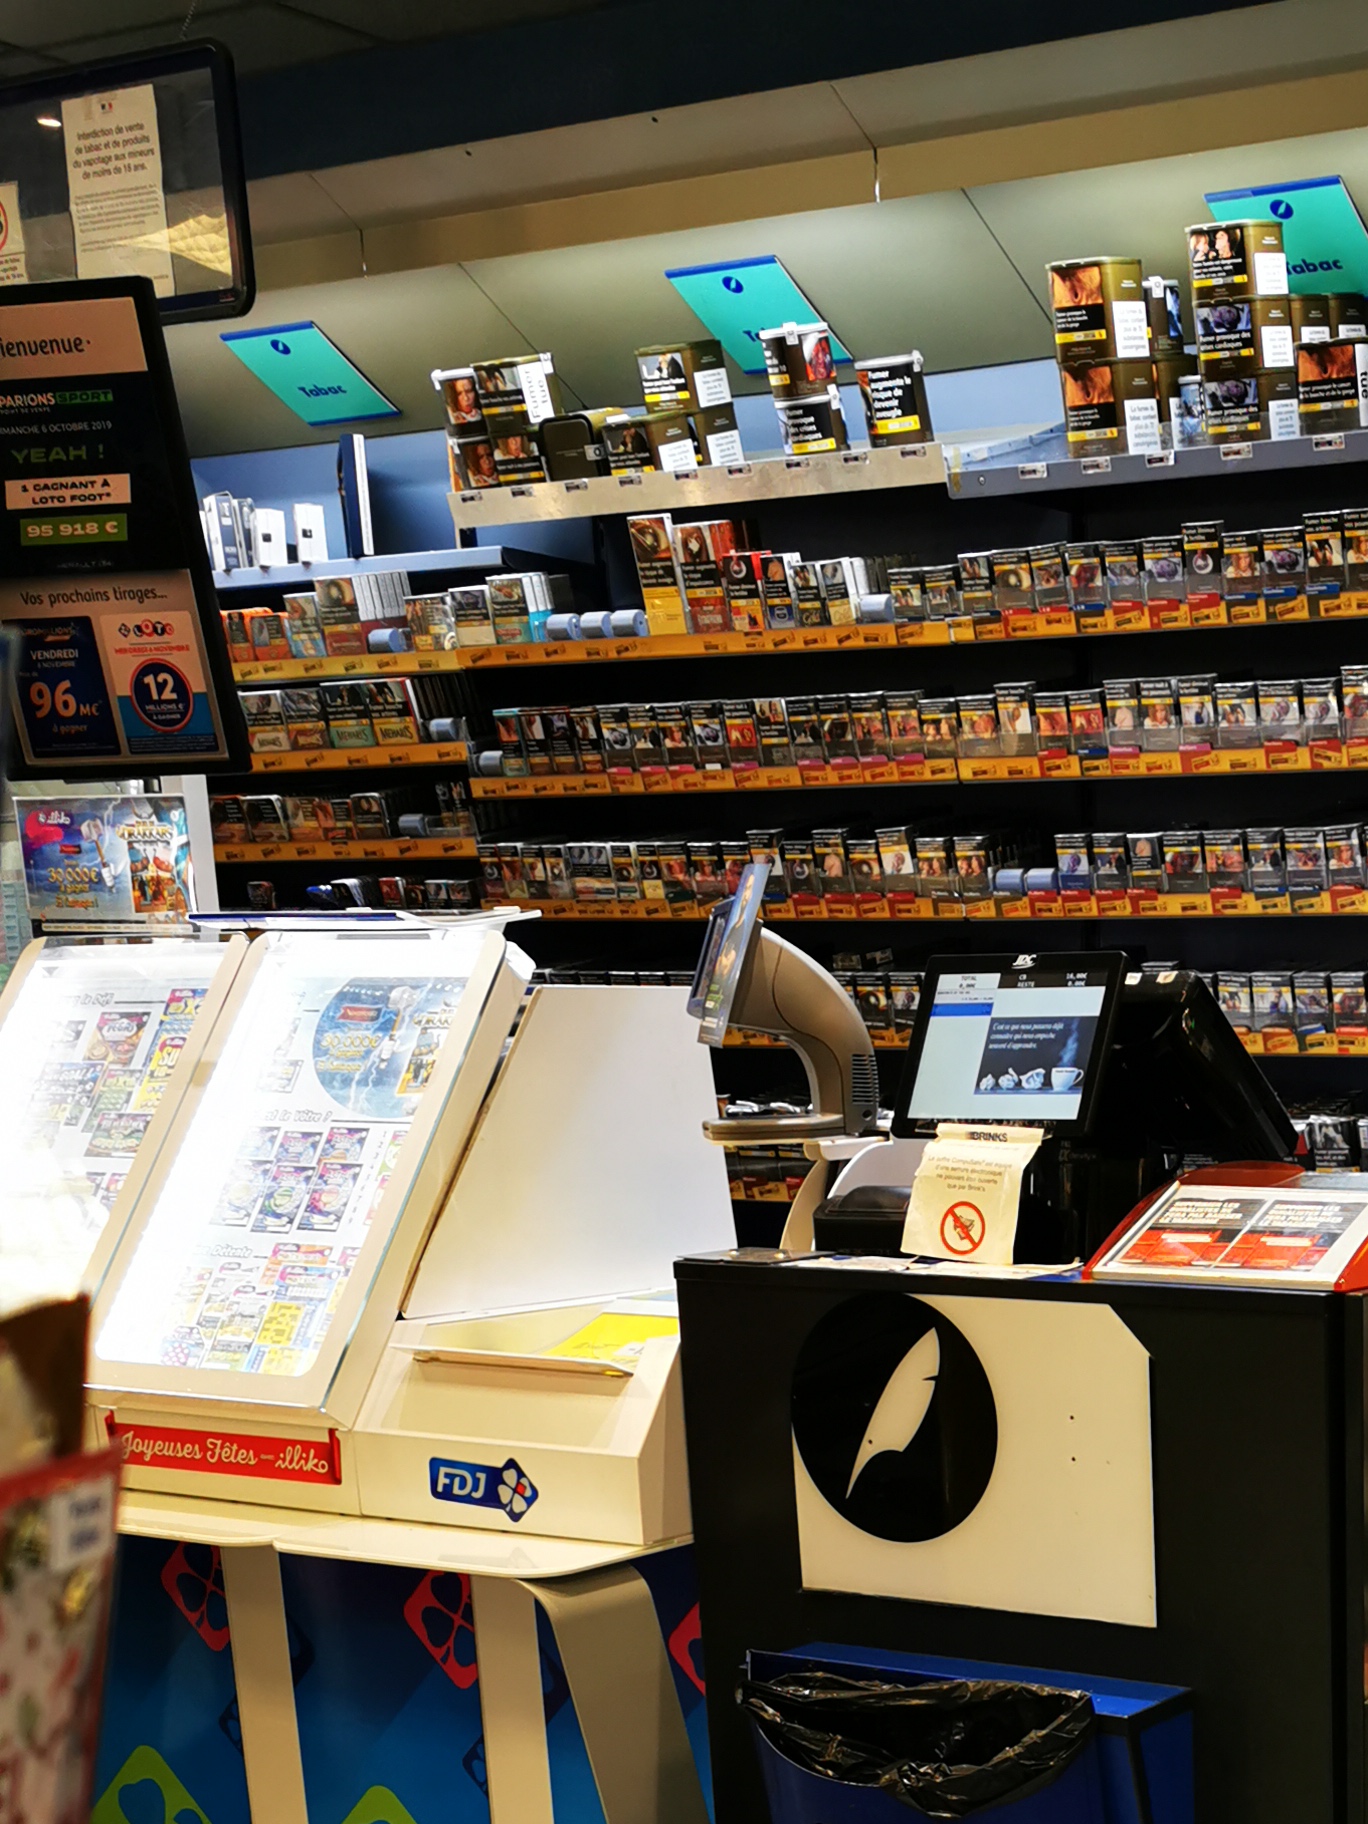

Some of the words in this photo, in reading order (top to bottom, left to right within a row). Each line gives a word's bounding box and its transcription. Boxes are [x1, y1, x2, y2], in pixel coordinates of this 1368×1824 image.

[115, 125, 124, 135] de
[126, 122, 145, 133] vente
[75, 146, 83, 156] de
[84, 142, 103, 154] tabac
[104, 140, 111, 150] et
[112, 138, 121, 148] de
[122, 135, 151, 149] produits
[73, 159, 82, 169] du
[82, 154, 113, 168] vapotage
[128, 148, 155, 161] mineurs
[82, 170, 91, 180] de
[92, 166, 112, 179] moins
[113, 165, 122, 175] de
[123, 163, 132, 173] 18
[0, 336, 86, 359] ienvenue
[0, 392, 56, 408] PARIONS
[58, 390, 111, 404] SPORT
[298, 384, 348, 399] Tabac
[0, 425, 40, 436] IMANCHE
[49, 423, 90, 433] OCTOBRE
[91, 420, 113, 430] 2019
[11, 445, 88, 464] YEAH
[32, 494, 66, 505] LOTO
[26, 524, 54, 537] 95
[59, 522, 99, 536] 918
[20, 591, 44, 606] Vos
[48, 588, 110, 608] prochains
[30, 648, 79, 660] VENDREDI
[143, 672, 178, 700] 12
[29, 679, 77, 719] 96
[972, 1131, 1008, 1143] BRINKS
[120, 1430, 202, 1461] Joyeuses
[205, 1437, 259, 1465] Fêtes
[274, 1446, 329, 1474] illiko
[436, 1466, 487, 1499] FDJ
